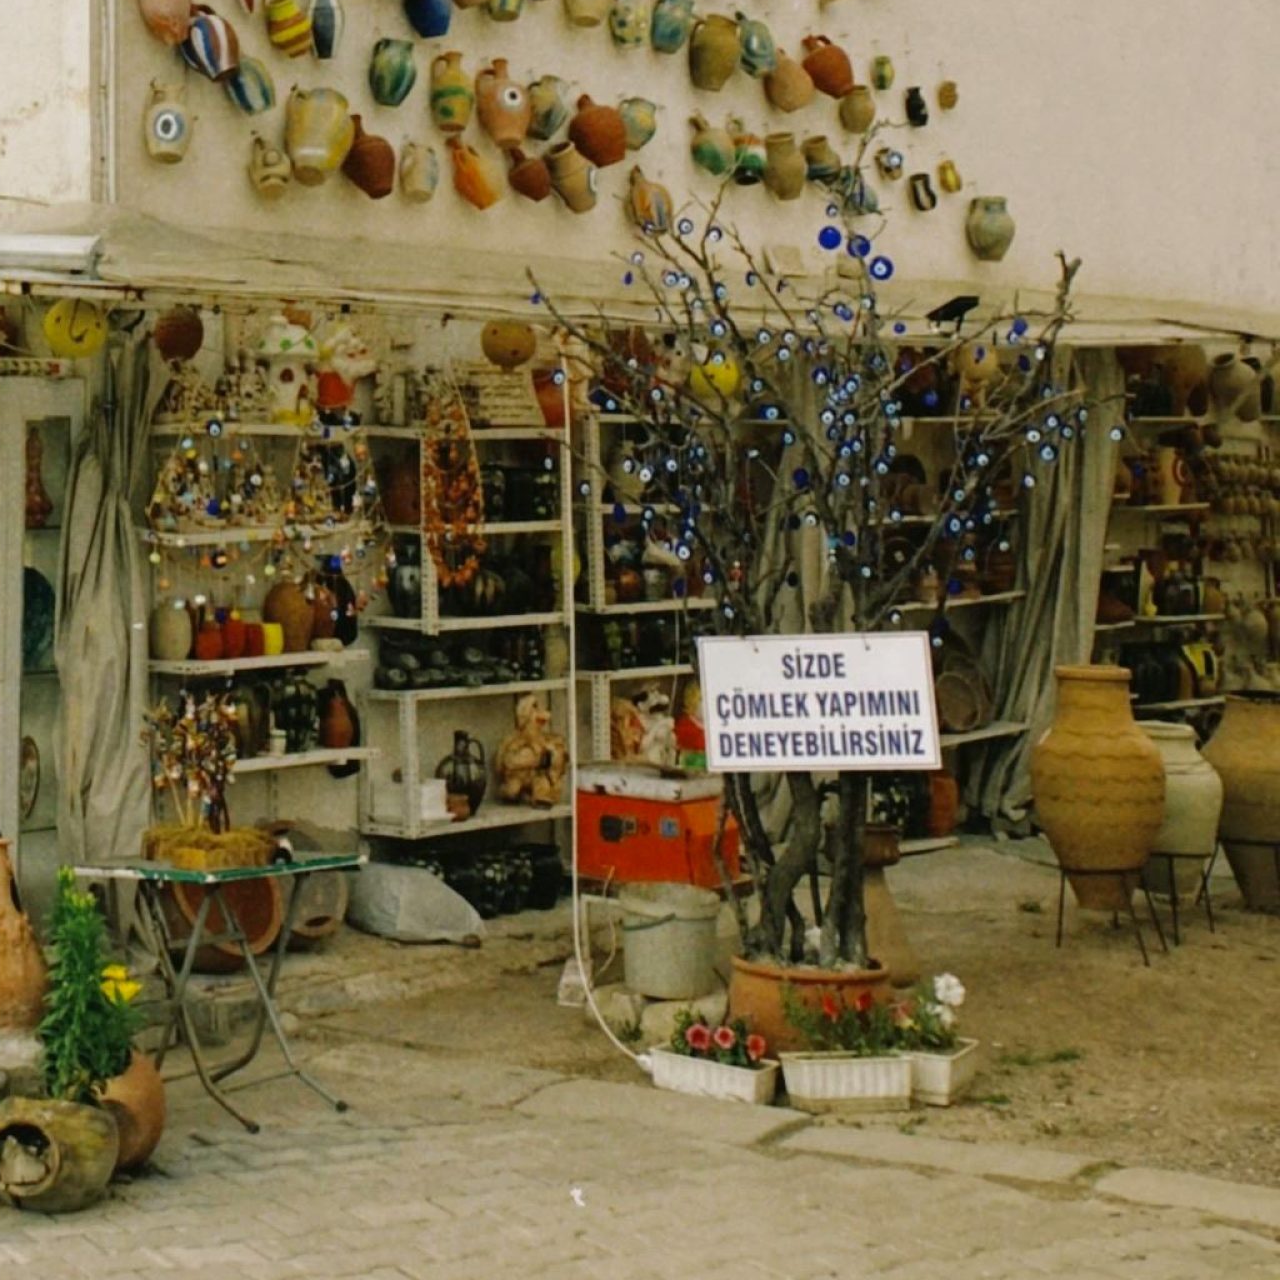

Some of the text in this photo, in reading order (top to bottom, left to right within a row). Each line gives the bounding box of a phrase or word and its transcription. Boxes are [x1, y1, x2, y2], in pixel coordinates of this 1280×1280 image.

[781, 647, 847, 679] SİZDE
[716, 686, 921, 727] ÇÖMLEK YAPIMINI
[719, 723, 926, 759] DENEYEBİLİRSİNİZ
